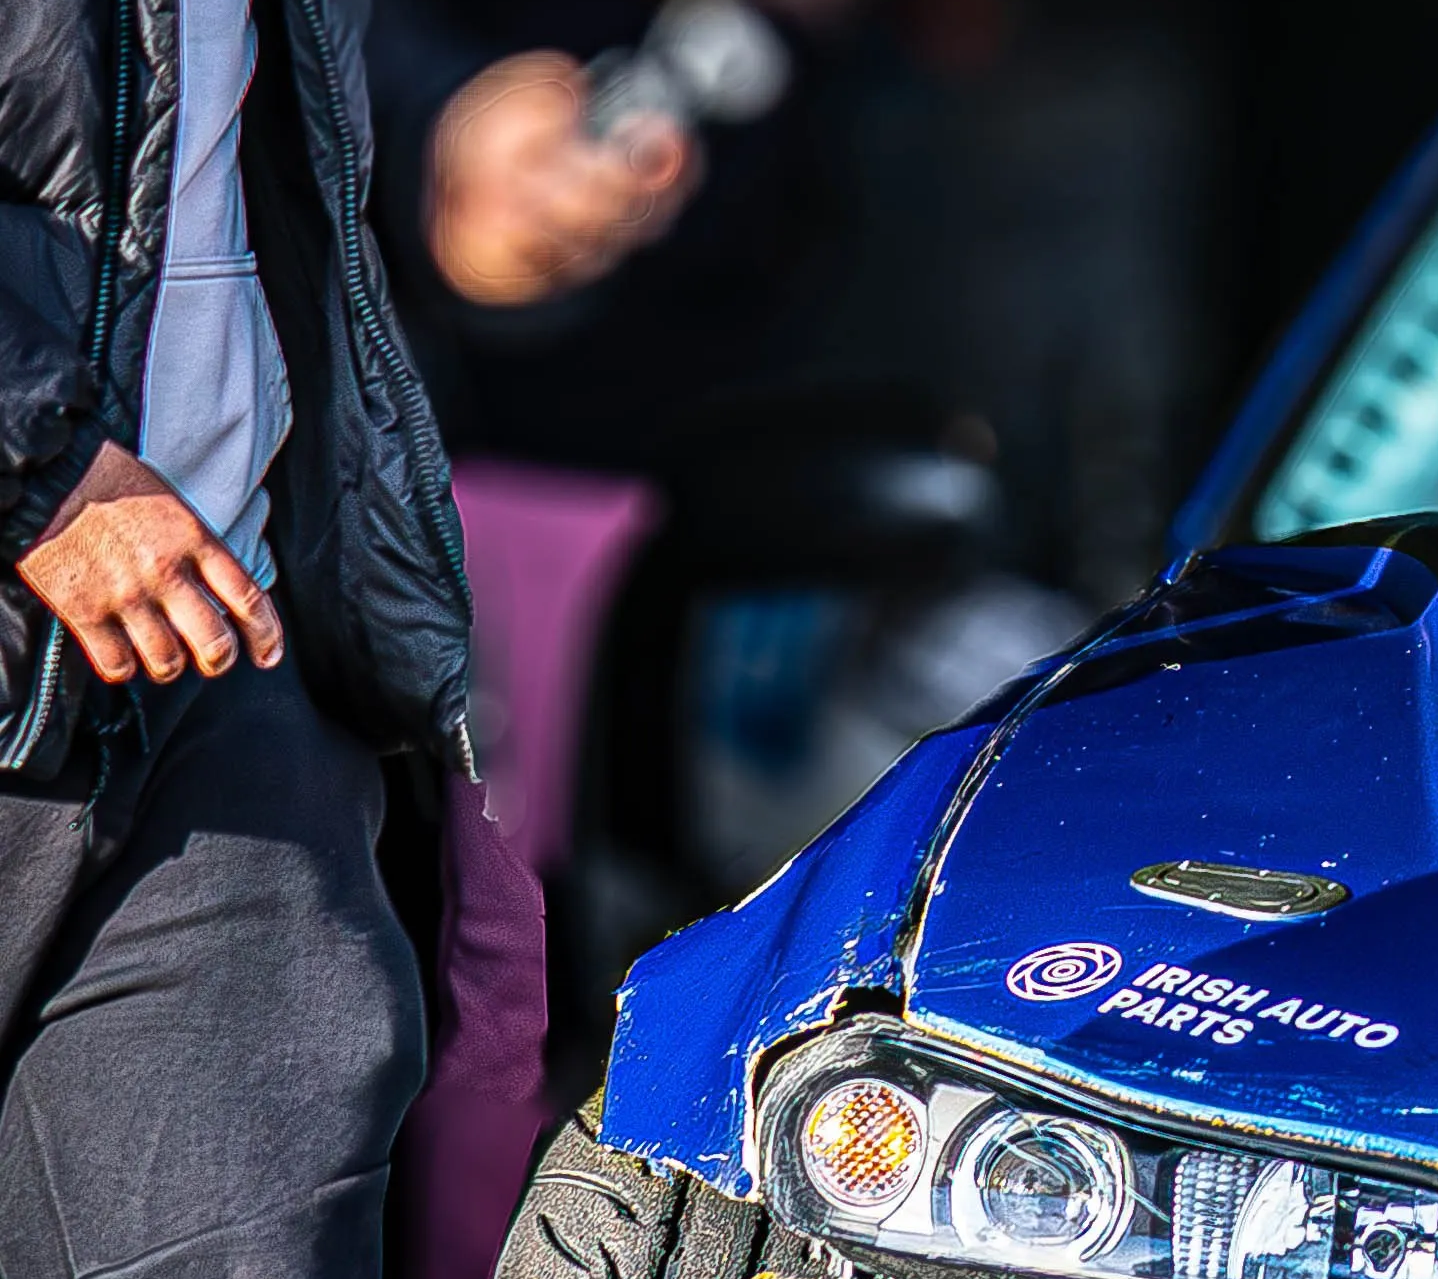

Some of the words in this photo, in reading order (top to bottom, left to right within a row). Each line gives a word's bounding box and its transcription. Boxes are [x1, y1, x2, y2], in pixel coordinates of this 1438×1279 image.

[1097, 988, 1254, 1045] PARTS
[1132, 963, 1270, 1012] IRISH
[1257, 999, 1400, 1049] AUTO
